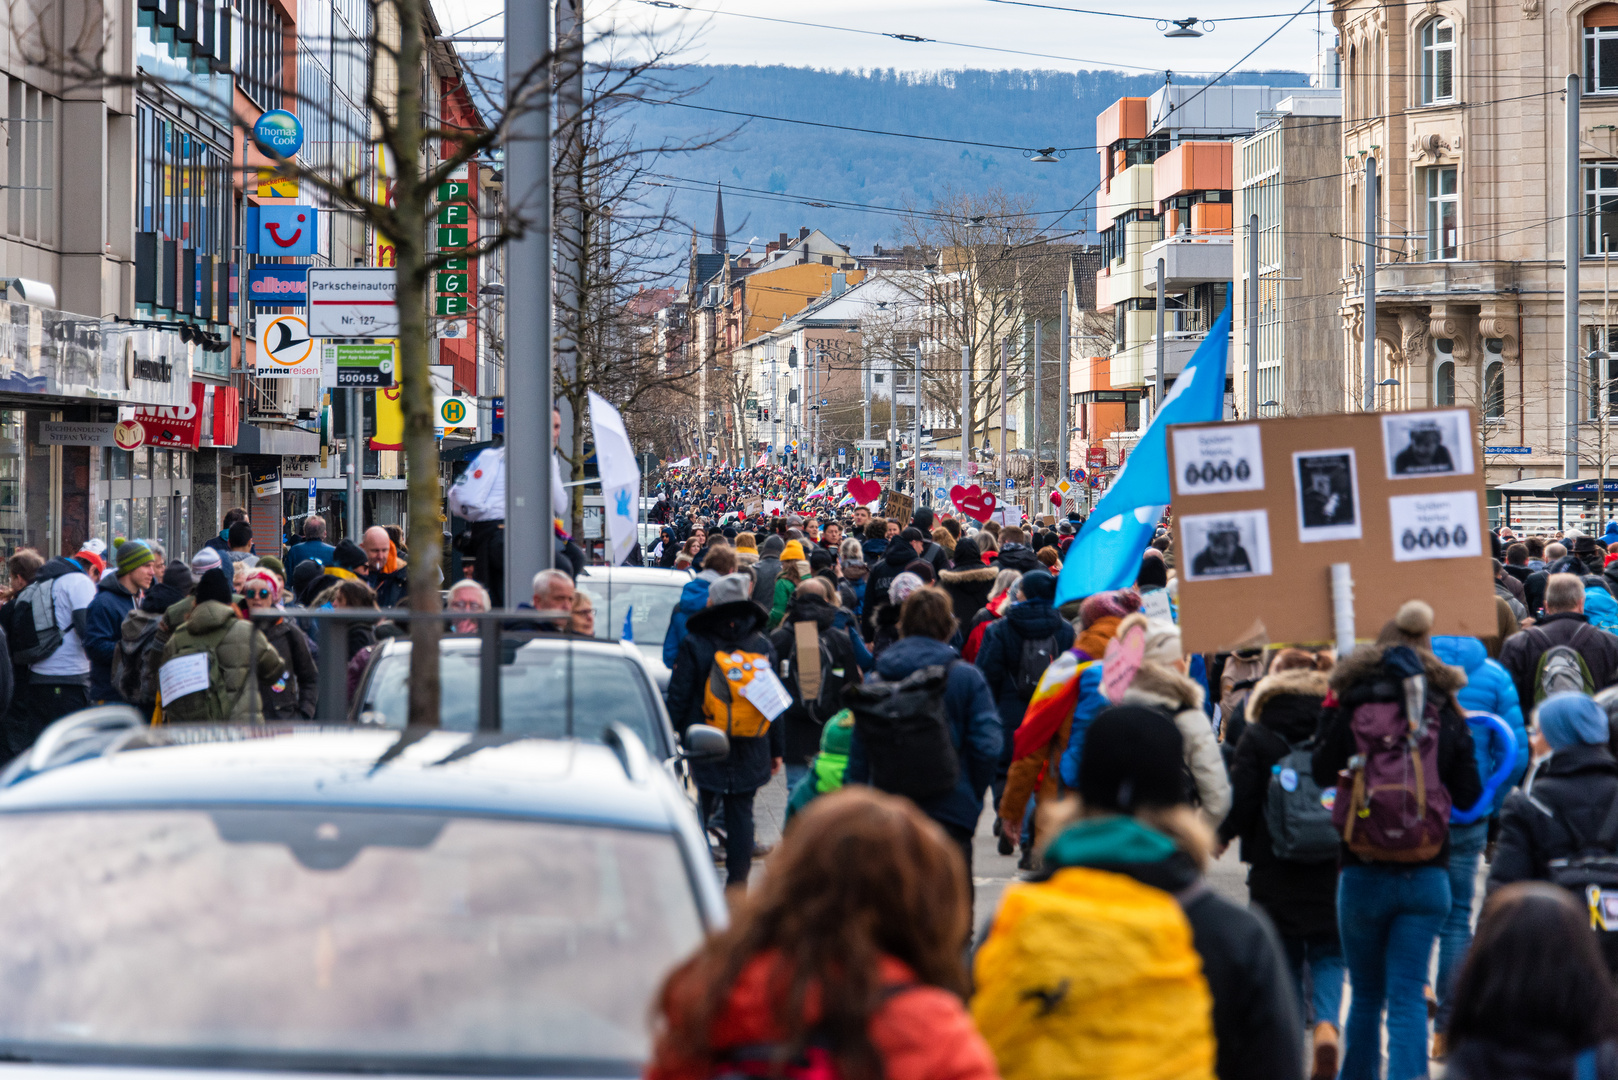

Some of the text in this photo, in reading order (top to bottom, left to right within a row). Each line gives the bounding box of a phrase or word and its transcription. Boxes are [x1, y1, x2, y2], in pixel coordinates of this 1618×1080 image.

[259, 127, 297, 136] Thomas
[272, 136, 296, 145] Cook
[312, 281, 397, 291] Parkscheinautom
[341, 316, 375, 325] Nr. 127
[339, 374, 379, 382] 500052
[447, 404, 460, 419] H
